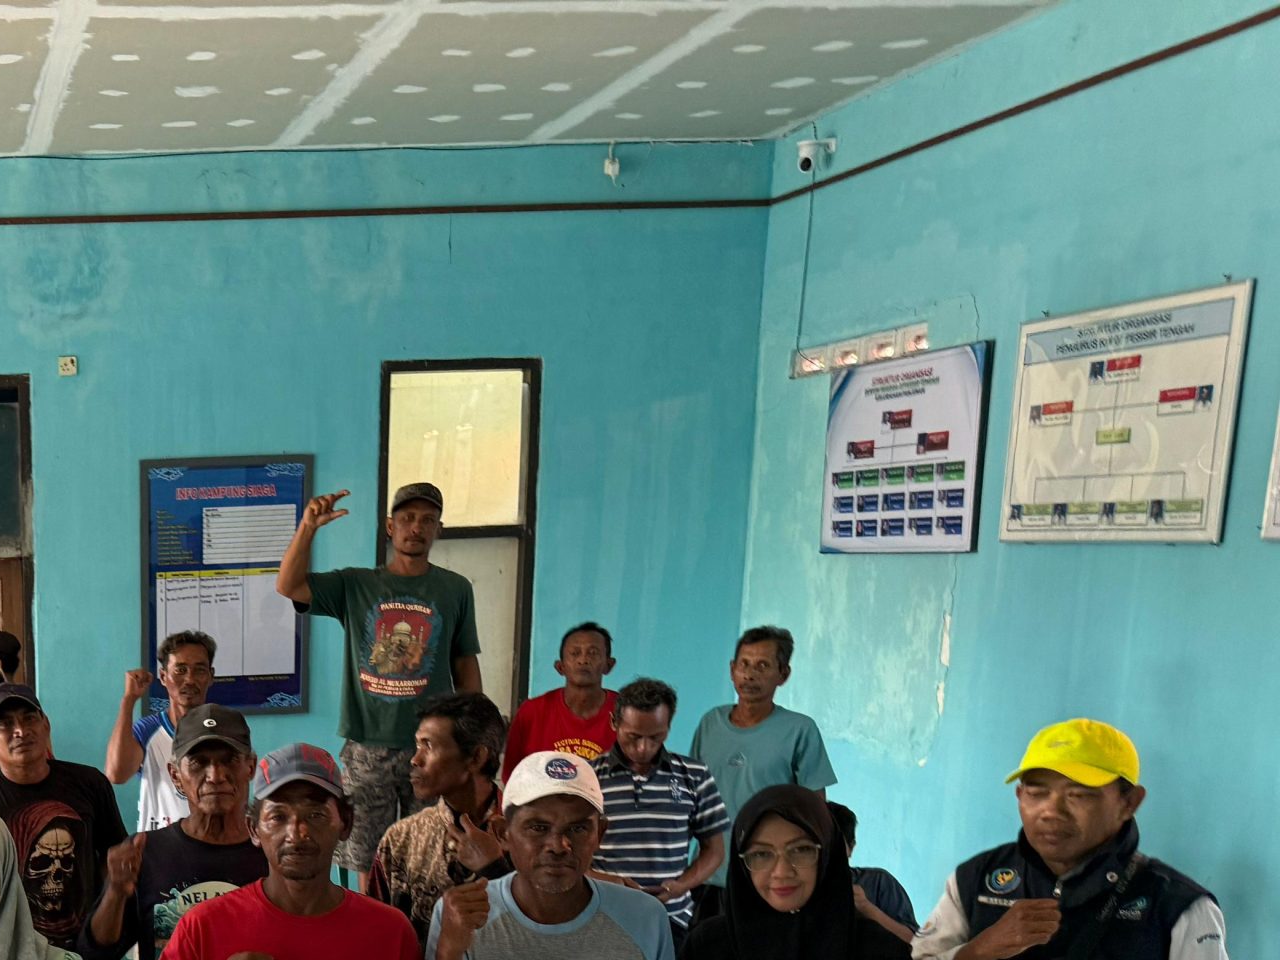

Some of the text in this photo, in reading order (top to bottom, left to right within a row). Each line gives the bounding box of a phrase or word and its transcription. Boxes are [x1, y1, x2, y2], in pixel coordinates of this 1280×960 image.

[176, 484, 277, 500] INFO KAMPUNG SIAGA
[548, 765, 576, 774] NASA
